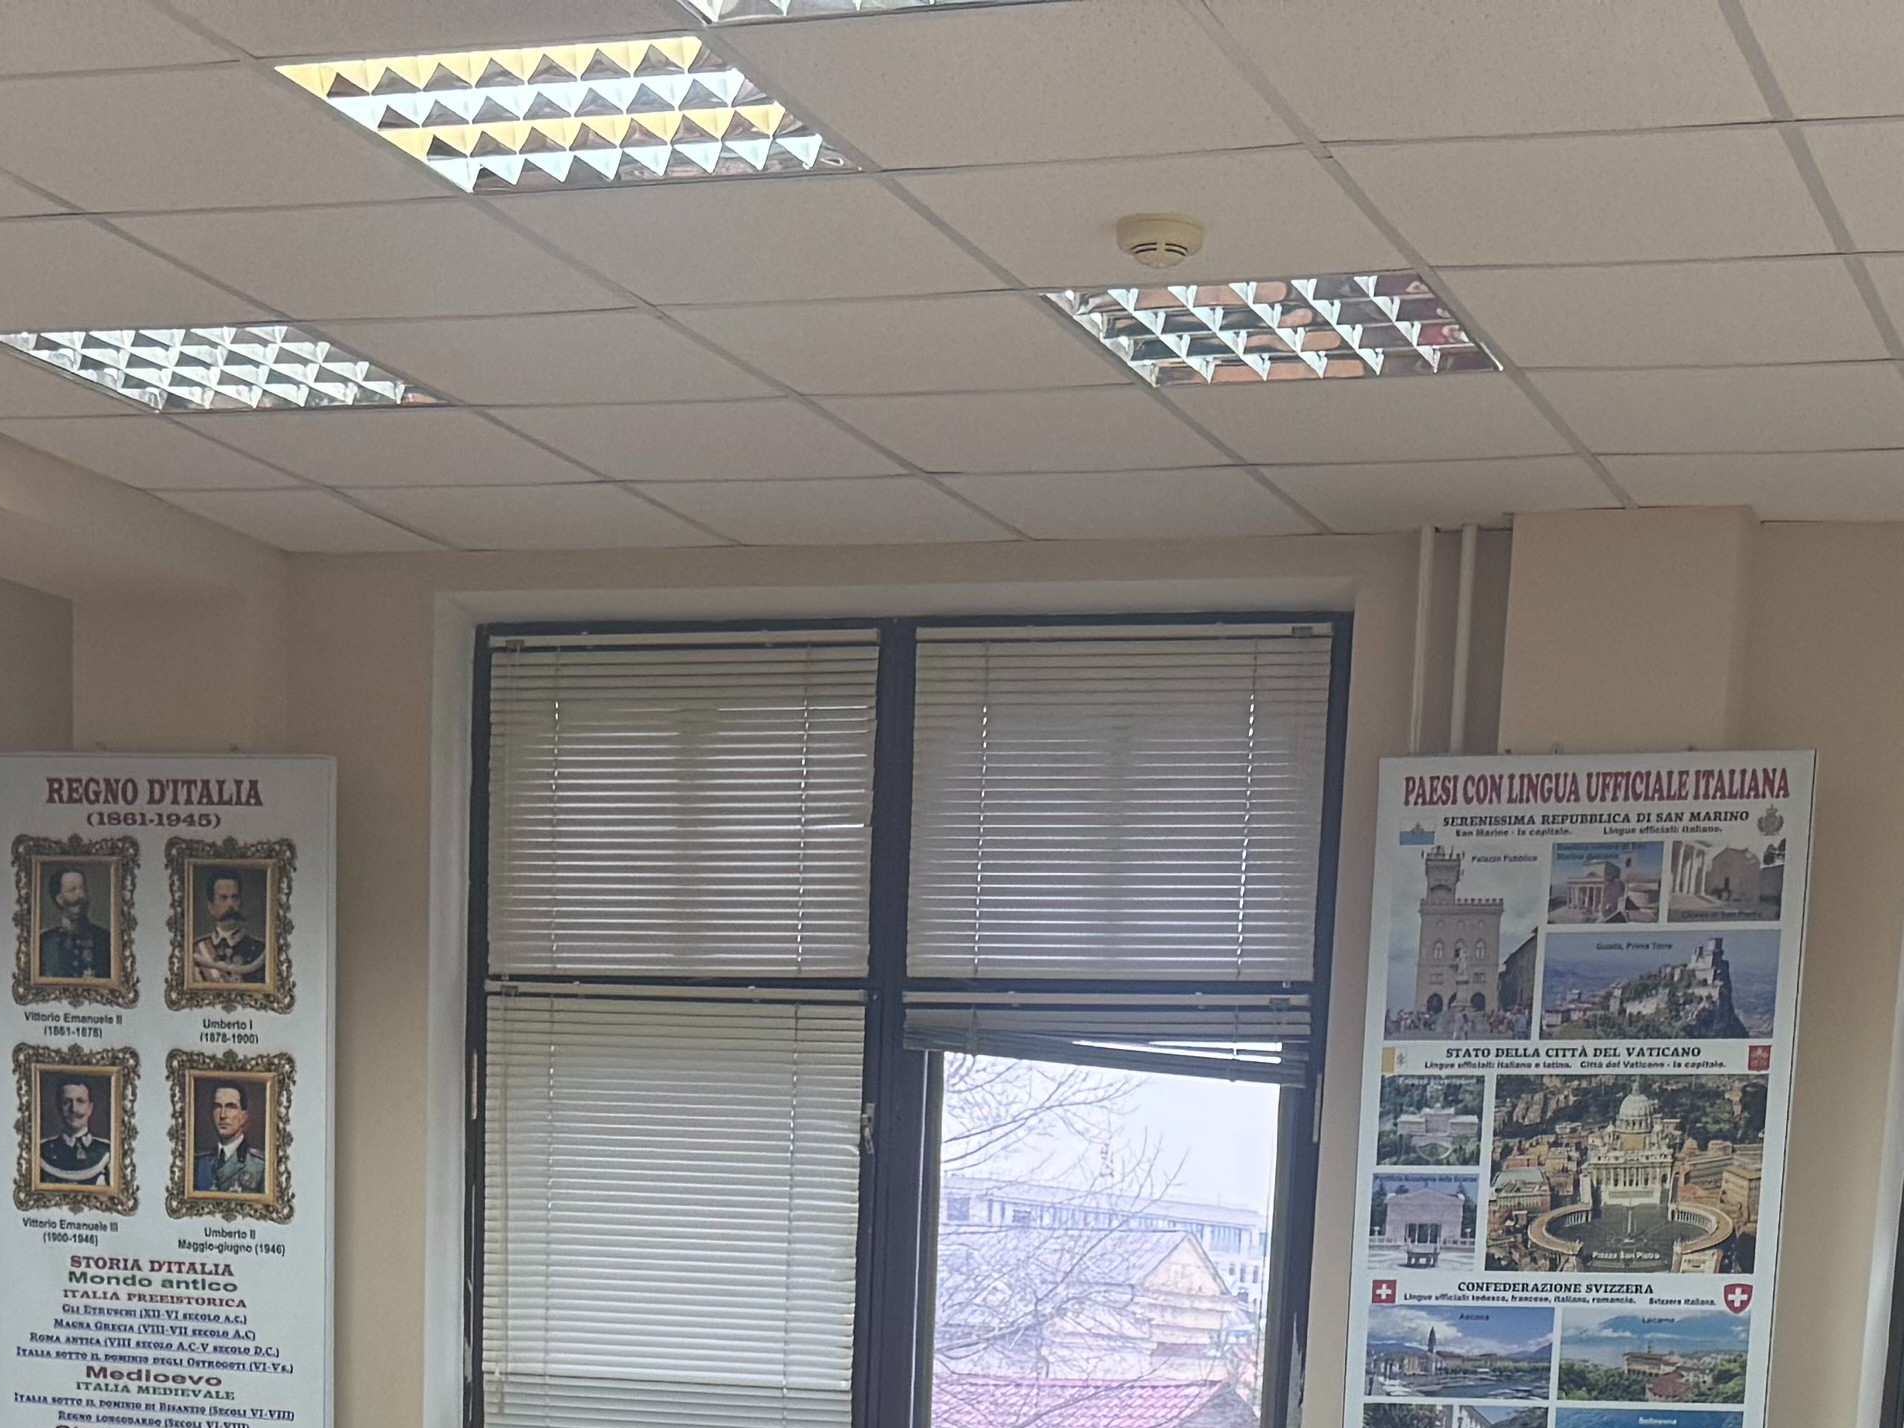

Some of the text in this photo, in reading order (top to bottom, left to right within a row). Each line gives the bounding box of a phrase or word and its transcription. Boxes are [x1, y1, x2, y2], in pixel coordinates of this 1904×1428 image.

[46, 777, 263, 807] REGNO D'ITALIA
[1404, 767, 1790, 806] PAESI CON LINGUA UFFICIALE ITALIANA
[87, 812, 221, 829] (1861-1945)
[1443, 809, 1749, 827] SERENISSIMA REPUBBLICA DI SAN MARINO
[24, 1012, 61, 1023] Vittorio
[63, 1013, 114, 1025] Emanuele
[202, 1018, 246, 1030] Umberto
[1446, 1044, 1701, 1058] STATO DELLA CITTÀ DEL VATICANO
[22, 1217, 57, 1229] Vittorio
[59, 1219, 108, 1232] Emanuele
[204, 1227, 247, 1239] Umberto
[43, 1232, 99, 1246] (1900-1946)
[177, 1239, 286, 1257] Maggio-giugno (1946)
[70, 1255, 235, 1277] STORIA D'ITALIA
[67, 1271, 238, 1292] Mondo antico
[1457, 1281, 1654, 1294] CONFEDERAZIONE SVIZZERA
[63, 1289, 120, 1302] ITALIA
[85, 1365, 222, 1387] Medioevo
[76, 1381, 235, 1400] ITALIA MEDIEVALE
